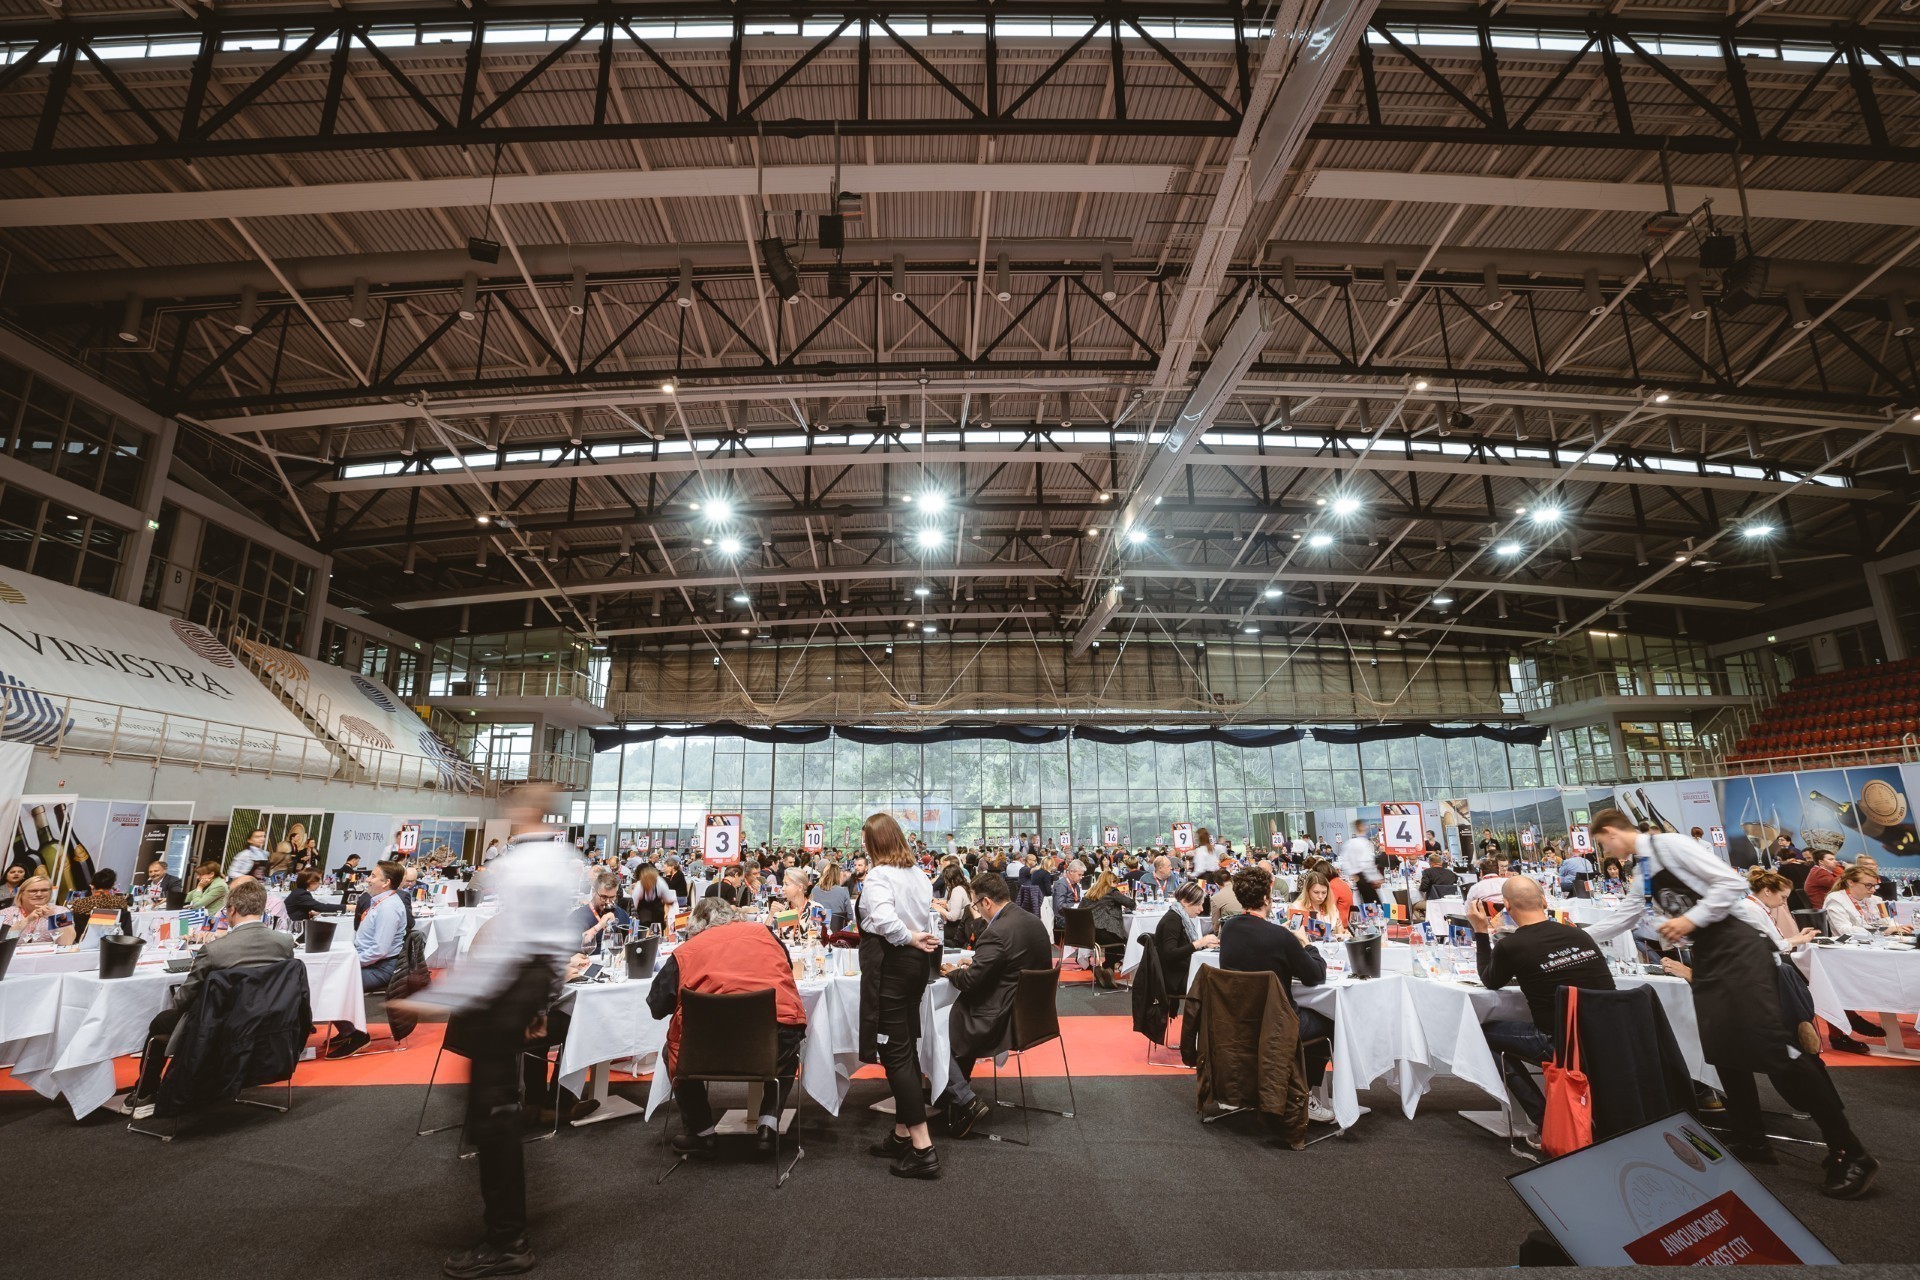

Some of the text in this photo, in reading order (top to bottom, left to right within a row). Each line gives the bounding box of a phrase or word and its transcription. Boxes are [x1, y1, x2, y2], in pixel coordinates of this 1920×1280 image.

[174, 570, 182, 584] B
[0, 622, 235, 701] VINISTRA
[1107, 833, 1116, 842] 16
[1395, 820, 1412, 843] 4
[1714, 833, 1724, 842] 18
[403, 834, 415, 847] 11
[640, 840, 648, 848] 23
[715, 831, 730, 853] 3
[808, 833, 820, 845] 10
[1062, 836, 1069, 844] 21
[1179, 832, 1187, 845] 9
[1273, 836, 1281, 844] 20
[1577, 834, 1586, 847] 8
[1659, 1208, 1729, 1257] ANNOUNCMENT
[1728, 1235, 1754, 1258] CITY
